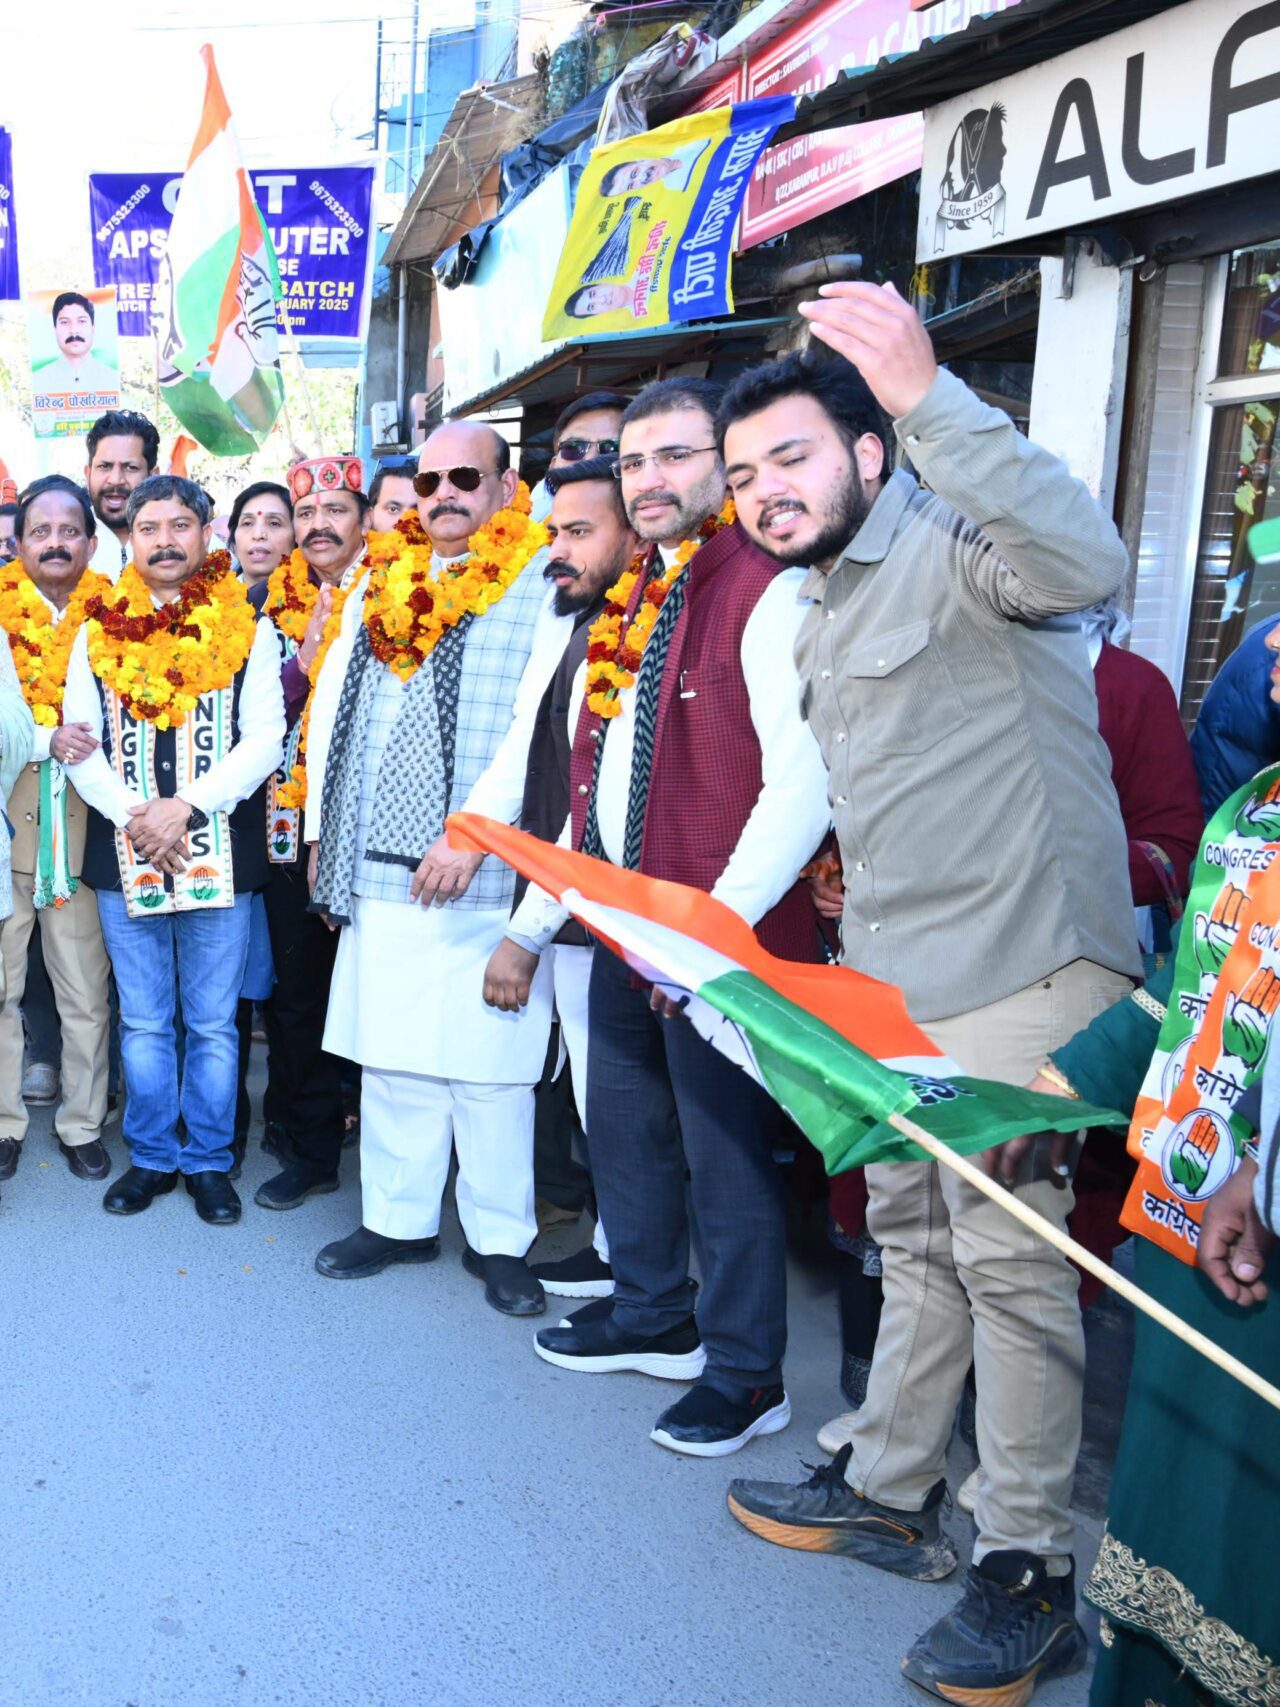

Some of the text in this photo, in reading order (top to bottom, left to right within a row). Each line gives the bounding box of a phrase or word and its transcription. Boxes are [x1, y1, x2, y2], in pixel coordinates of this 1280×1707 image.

[309, 180, 364, 239] 9675323300
[948, 192, 993, 217] Since 1959
[271, 227, 350, 256] UTER
[117, 300, 147, 312] ATCH
[318, 299, 349, 311] 2025
[1205, 843, 1277, 871] CONGRES
